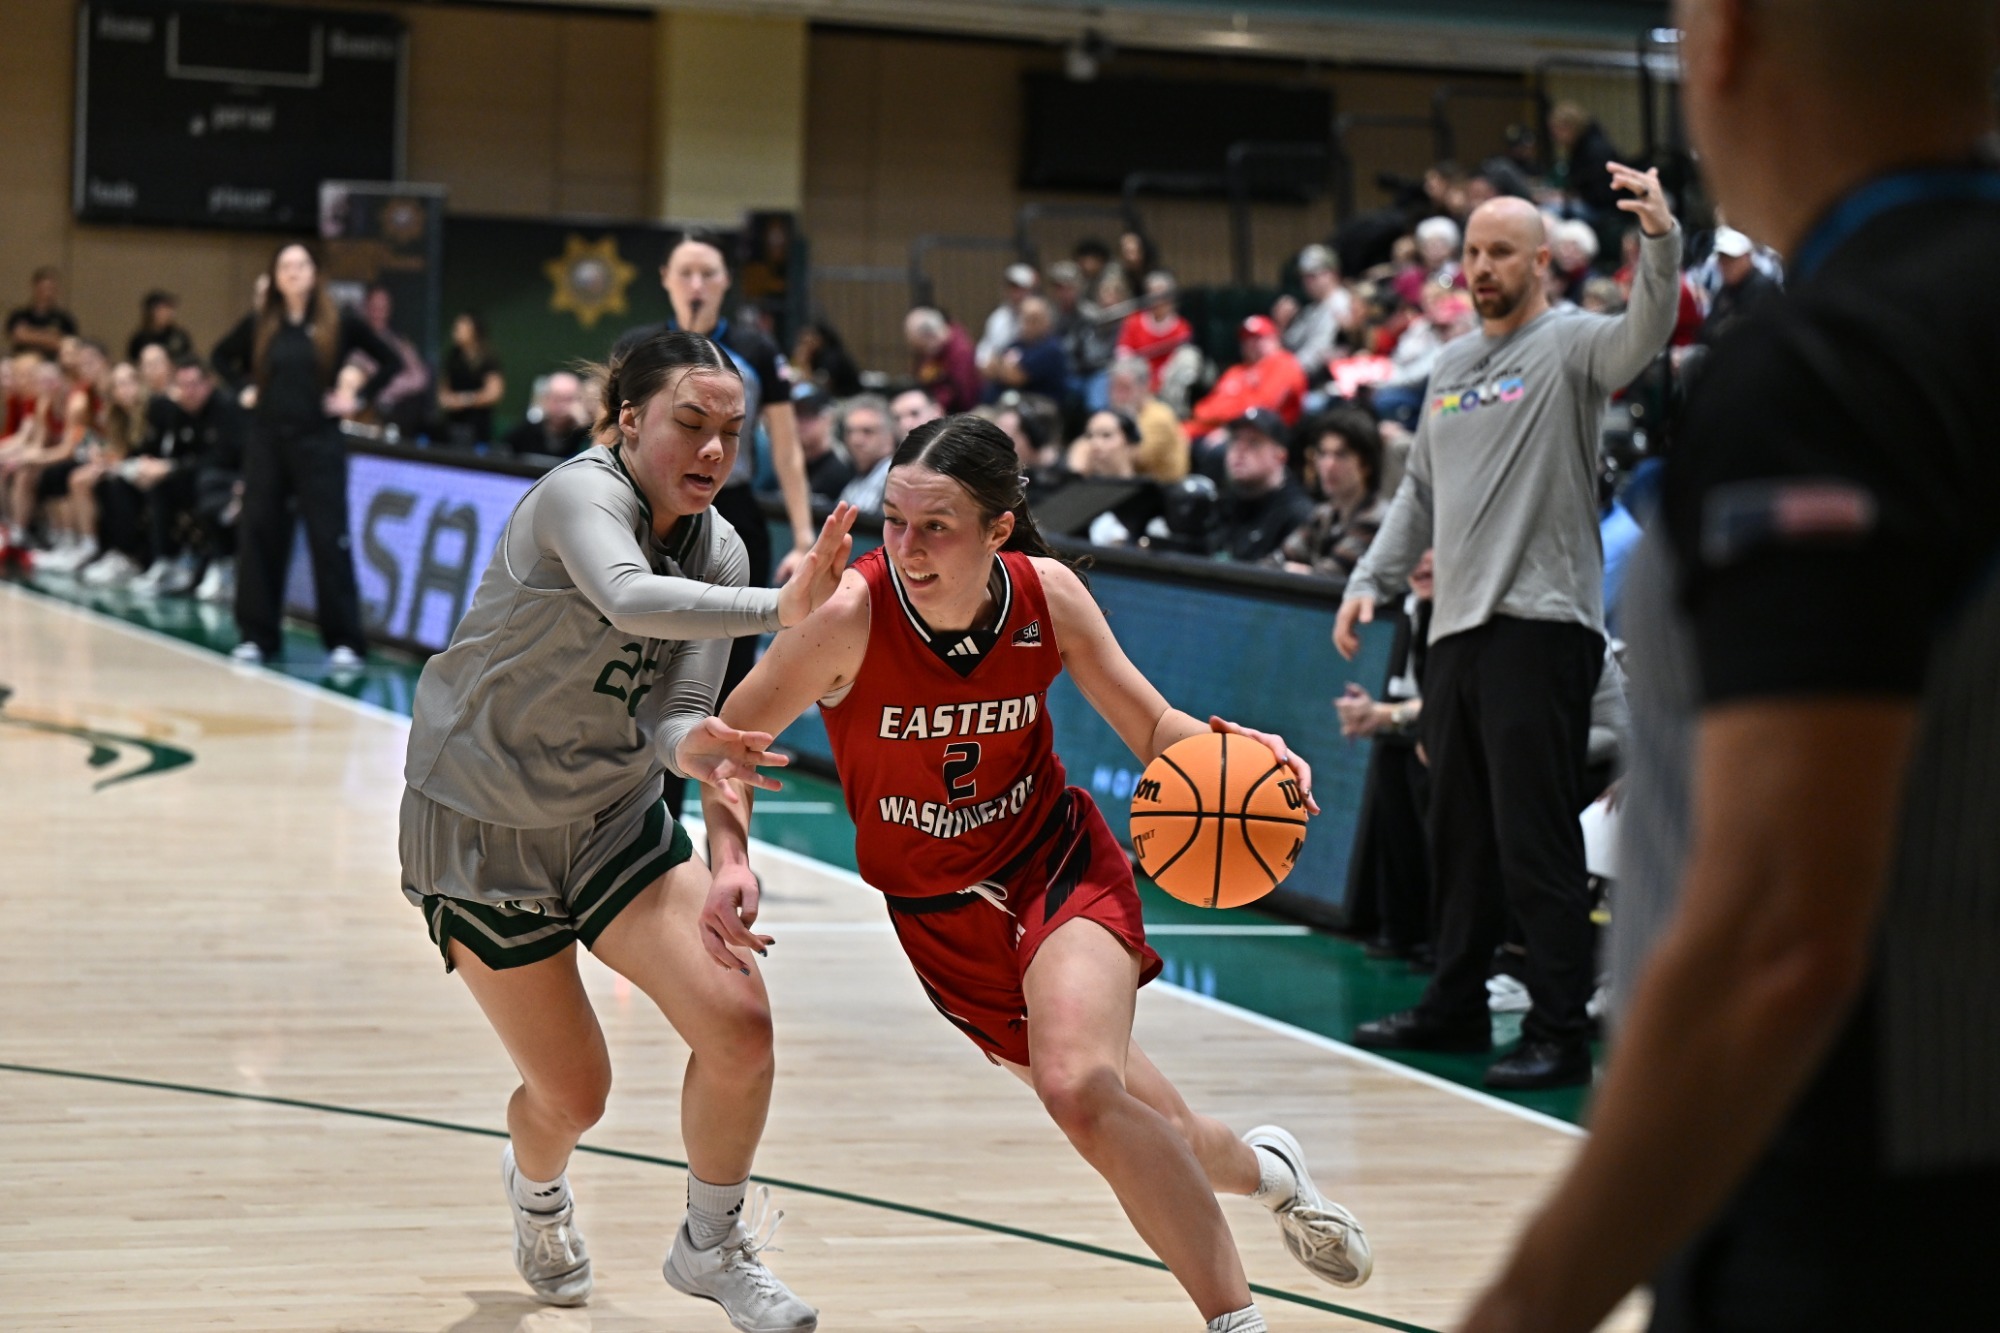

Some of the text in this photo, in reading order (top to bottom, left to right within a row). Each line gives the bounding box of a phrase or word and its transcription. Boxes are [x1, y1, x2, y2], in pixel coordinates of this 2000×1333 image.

[1023, 623, 1039, 639] SKY
[878, 692, 1044, 740] EASTERN
[942, 741, 981, 805] 2
